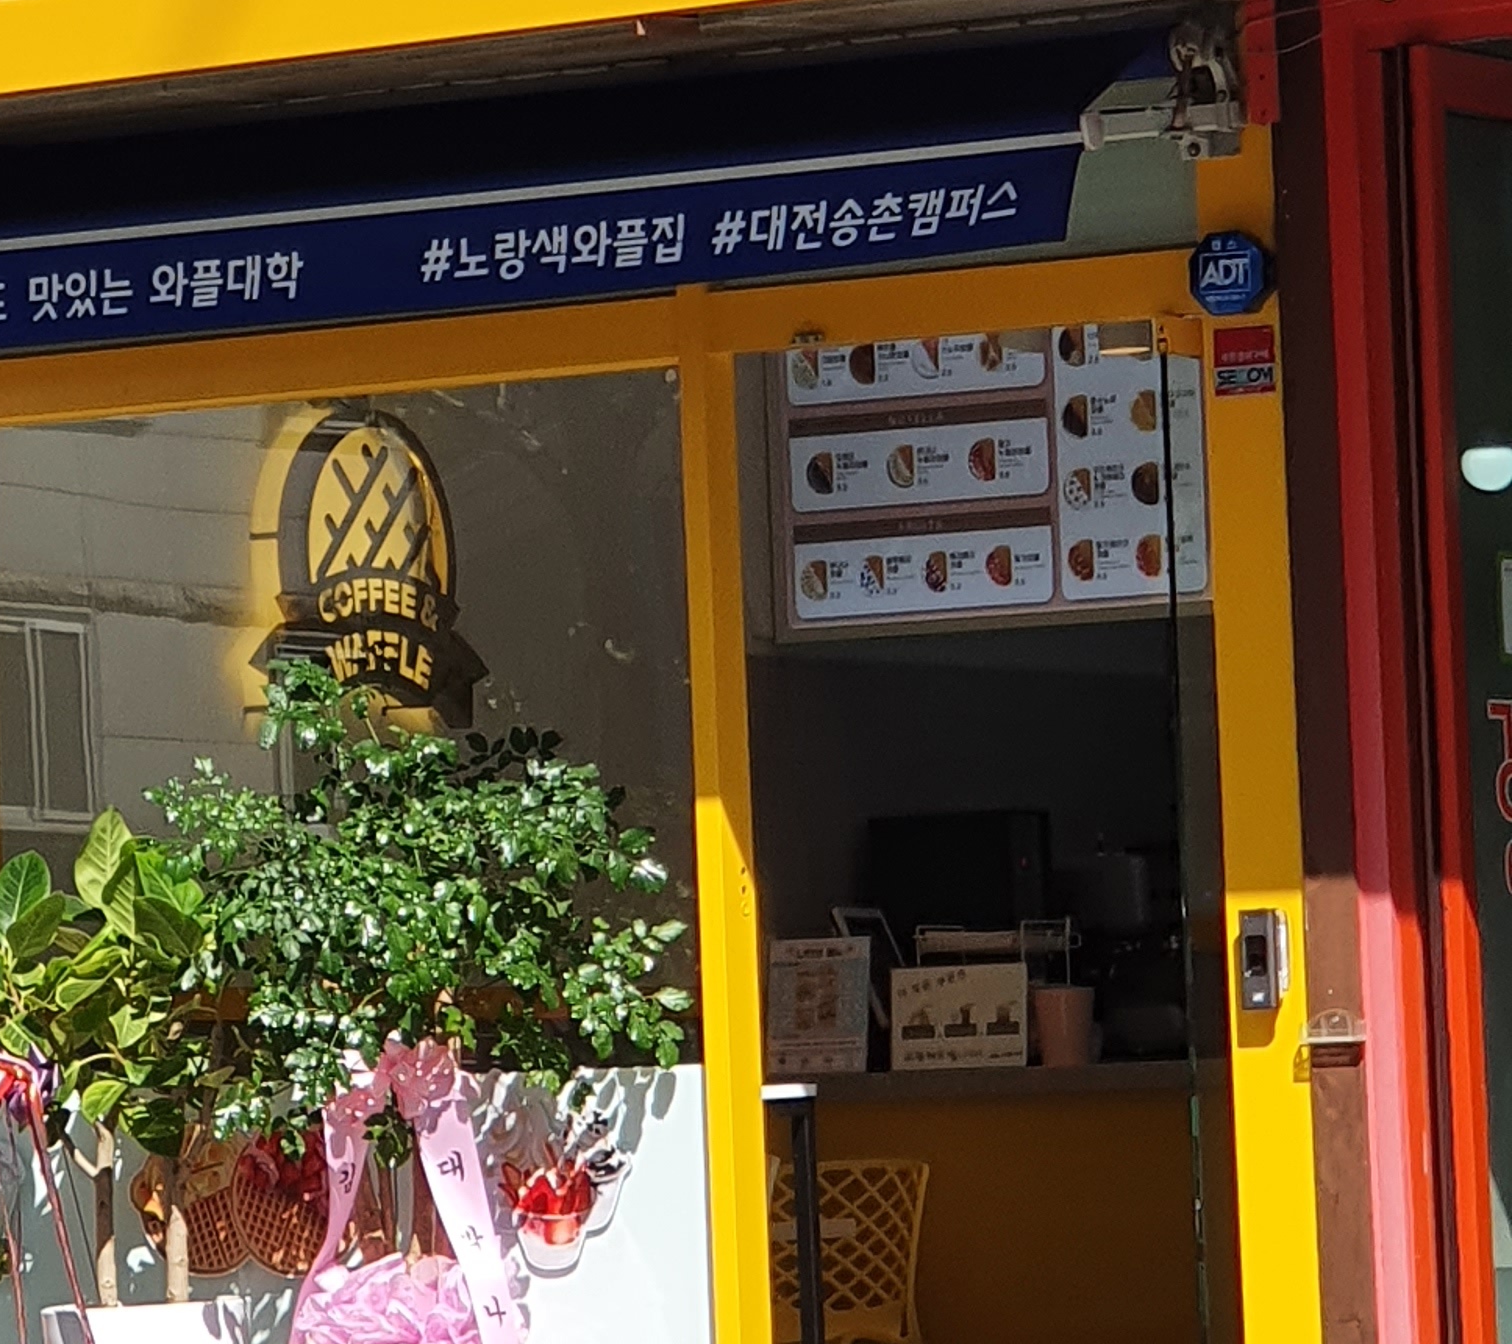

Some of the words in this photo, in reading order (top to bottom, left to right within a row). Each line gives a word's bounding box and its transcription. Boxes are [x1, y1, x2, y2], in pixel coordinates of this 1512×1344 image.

[28, 269, 134, 323] 맛있는
[149, 251, 303, 308] 와플대학
[421, 213, 686, 283] #노랑색와플집
[711, 181, 1018, 255] #대전송촌캠퍼스
[1199, 258, 1249, 288] ADT
[318, 578, 417, 623] COFFEE
